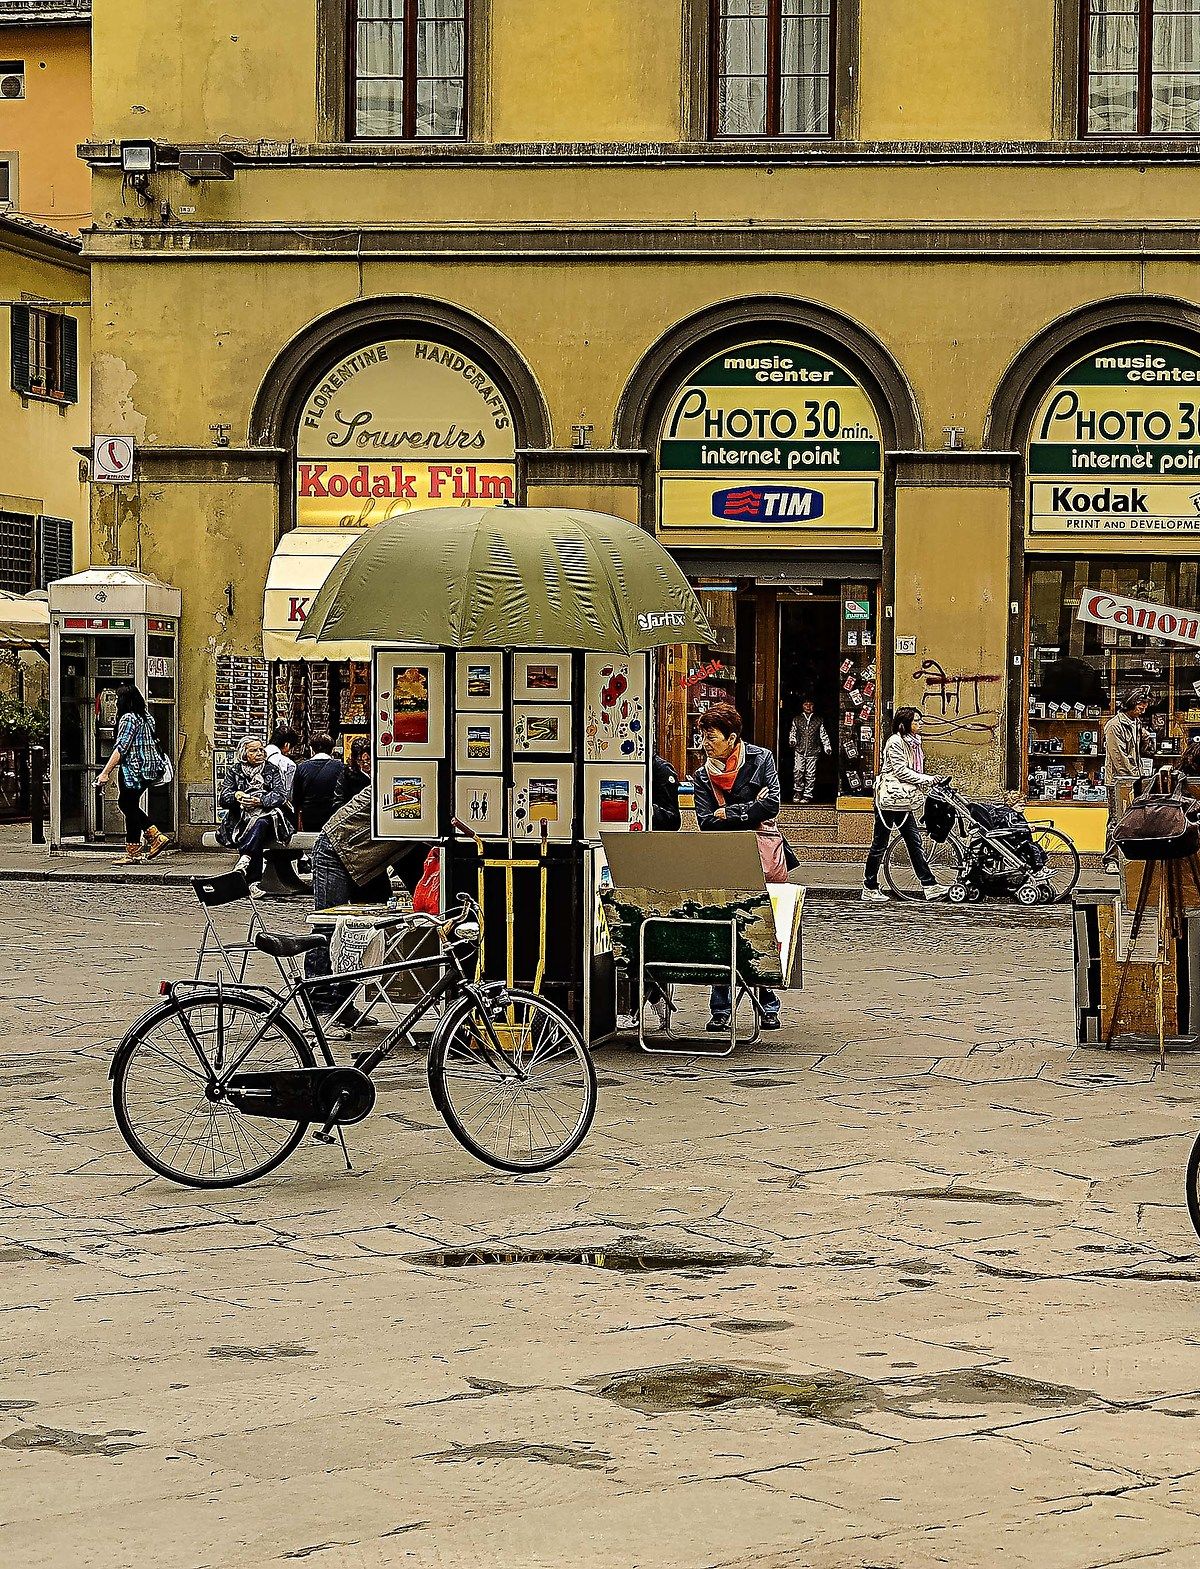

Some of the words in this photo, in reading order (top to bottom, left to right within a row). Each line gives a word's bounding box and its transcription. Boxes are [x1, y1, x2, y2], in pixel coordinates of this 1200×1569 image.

[724, 355, 794, 369] music
[755, 368, 834, 382] center
[1095, 355, 1166, 369] music
[304, 345, 389, 429] FLORENTINE
[414, 343, 511, 429] HANDCRAFTS
[669, 388, 798, 439] PHOTO
[803, 400, 841, 439] 30
[841, 422, 874, 440] min.
[1039, 390, 1172, 441] PHOTO
[327, 409, 486, 449] Souvenirs
[701, 445, 781, 465] internet
[787, 445, 840, 470] point
[1072, 449, 1153, 468] internet
[298, 464, 418, 498] Kodak
[427, 465, 515, 499] Film
[763, 493, 813, 517] TIM
[1052, 487, 1149, 513] Kodak
[1066, 519, 1101, 530] PRINT
[1104, 521, 1126, 530] AND
[1088, 594, 1199, 640] Canon
[680, 659, 726, 690] Kodak
